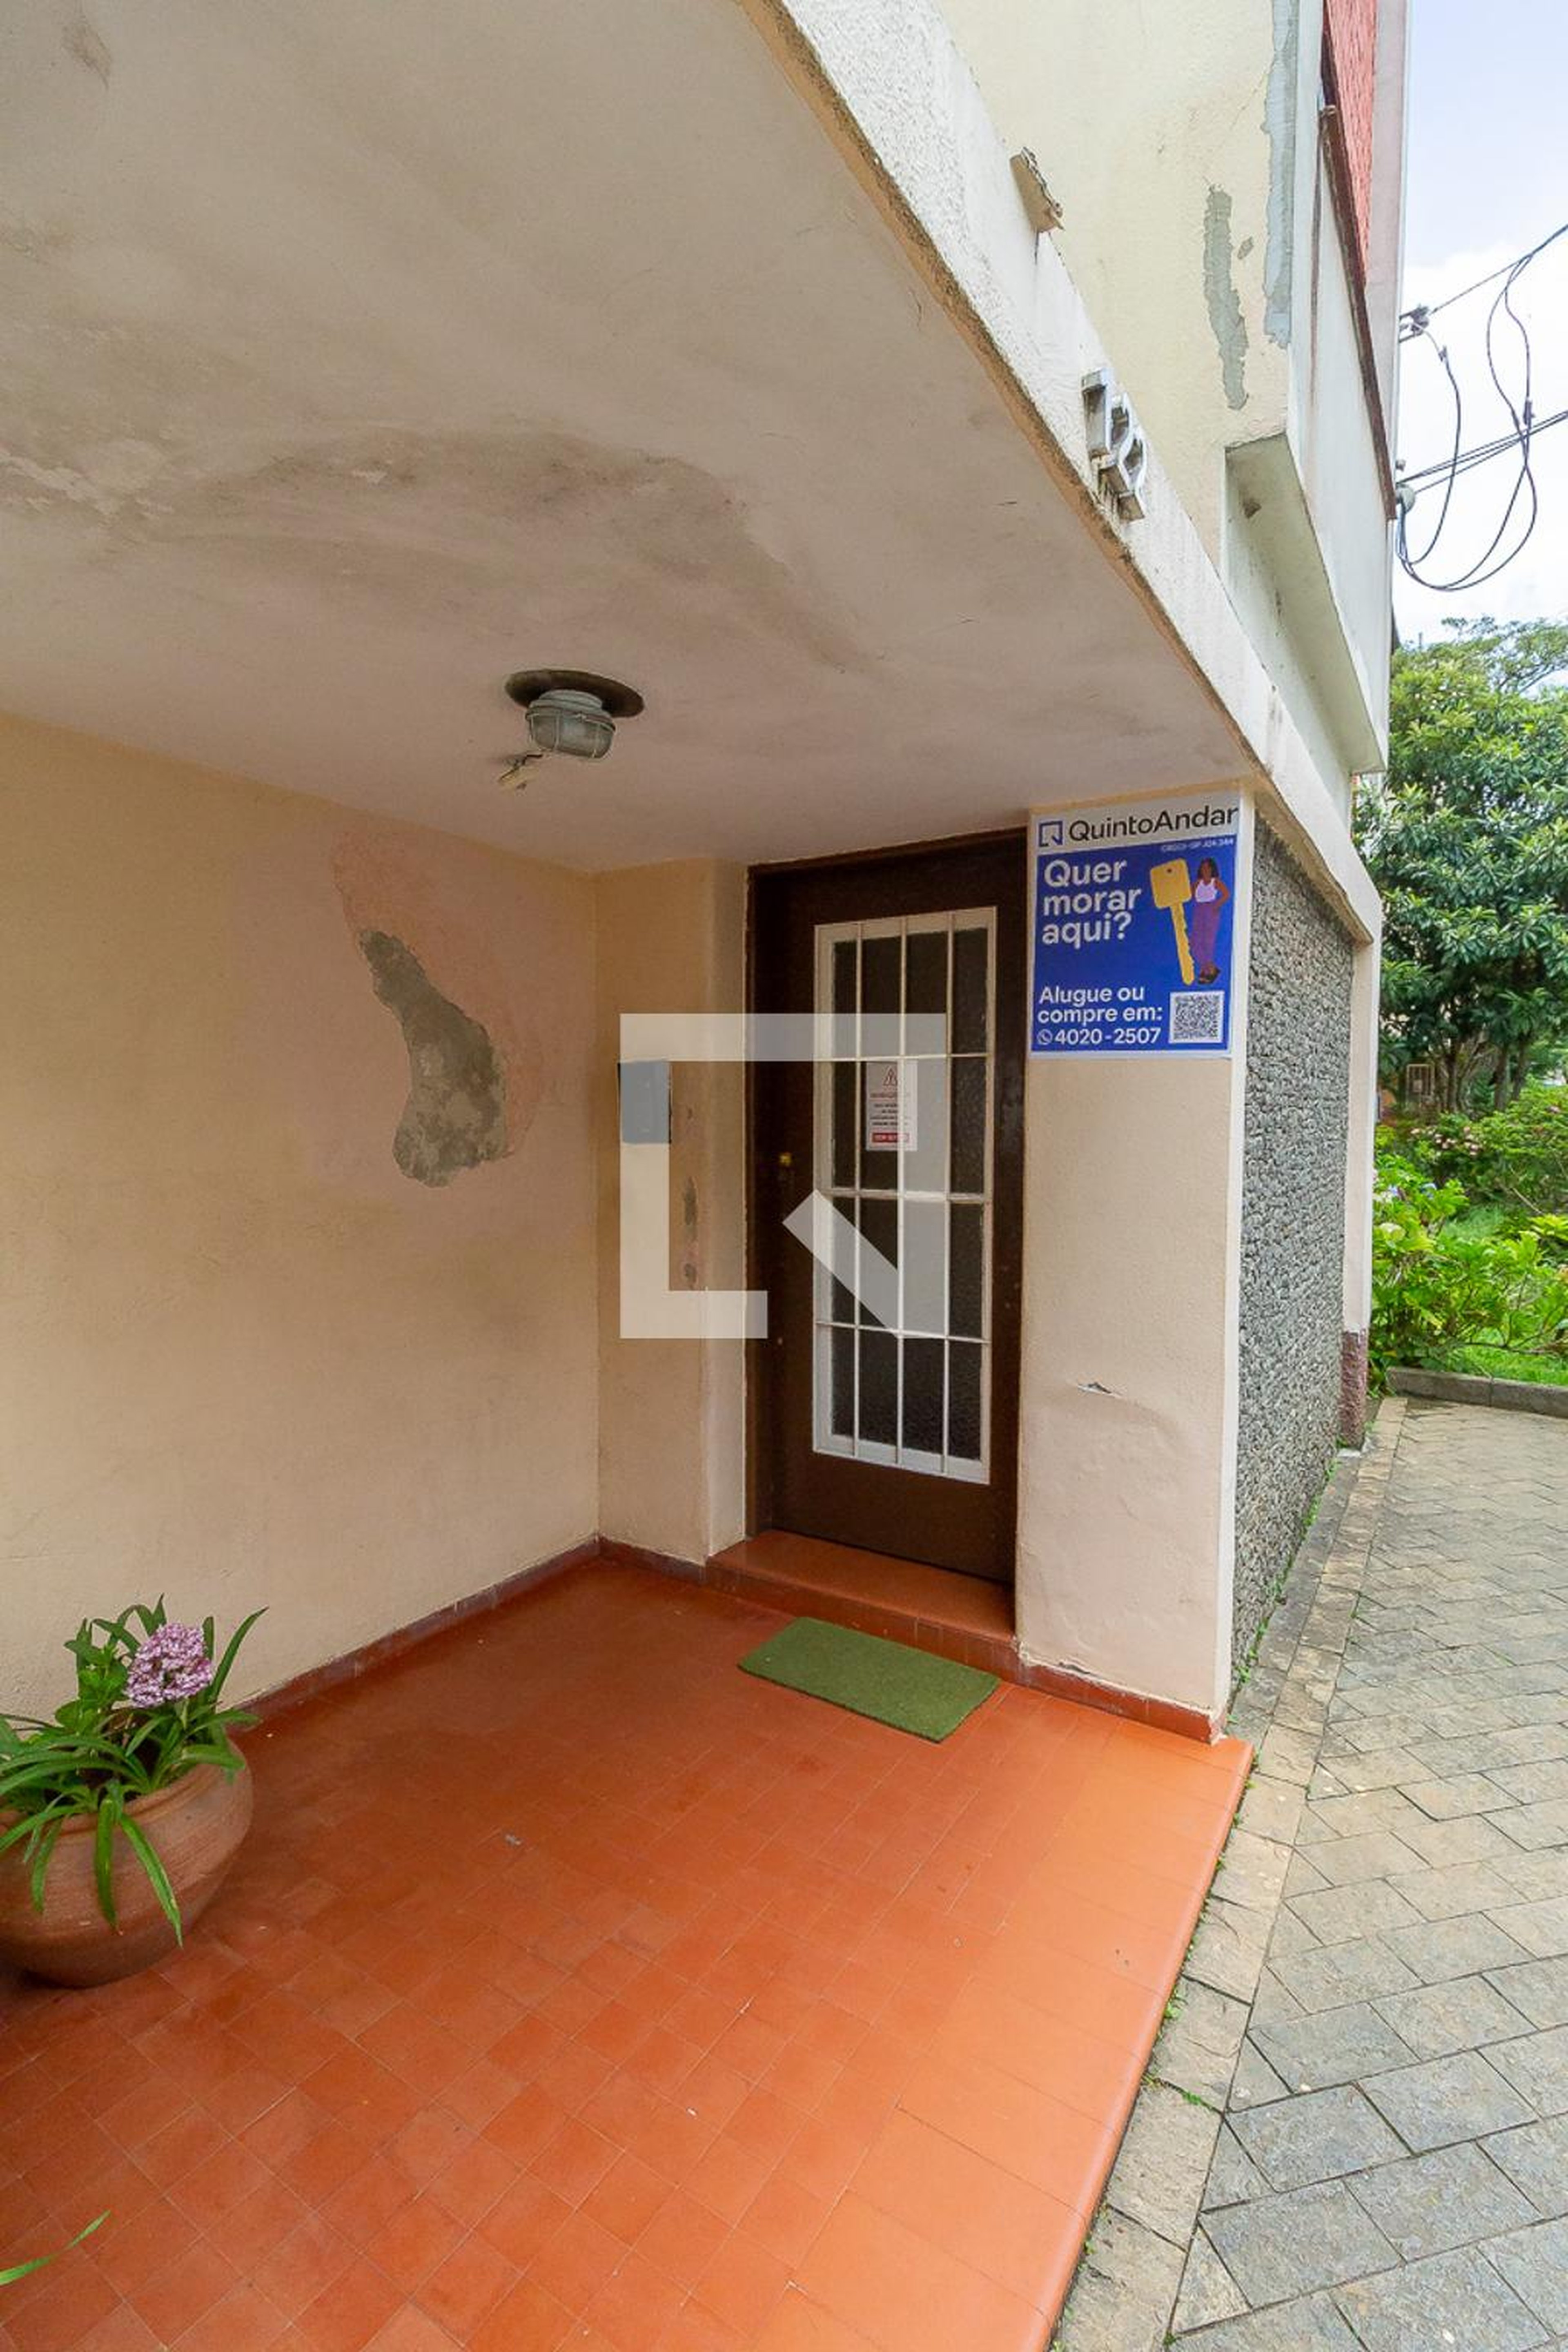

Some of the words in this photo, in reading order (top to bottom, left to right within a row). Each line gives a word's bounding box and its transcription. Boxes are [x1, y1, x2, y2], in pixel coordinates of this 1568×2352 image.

[1069, 805, 1239, 842] QuintoAndar
[1045, 859, 1127, 888] Quer
[1044, 889, 1142, 916] morar
[1042, 911, 1132, 949] aqui?
[1039, 986, 1112, 1007] Alugue
[1118, 987, 1144, 1001] ou
[1038, 1008, 1117, 1027] compre
[1123, 1006, 1163, 1021] em:
